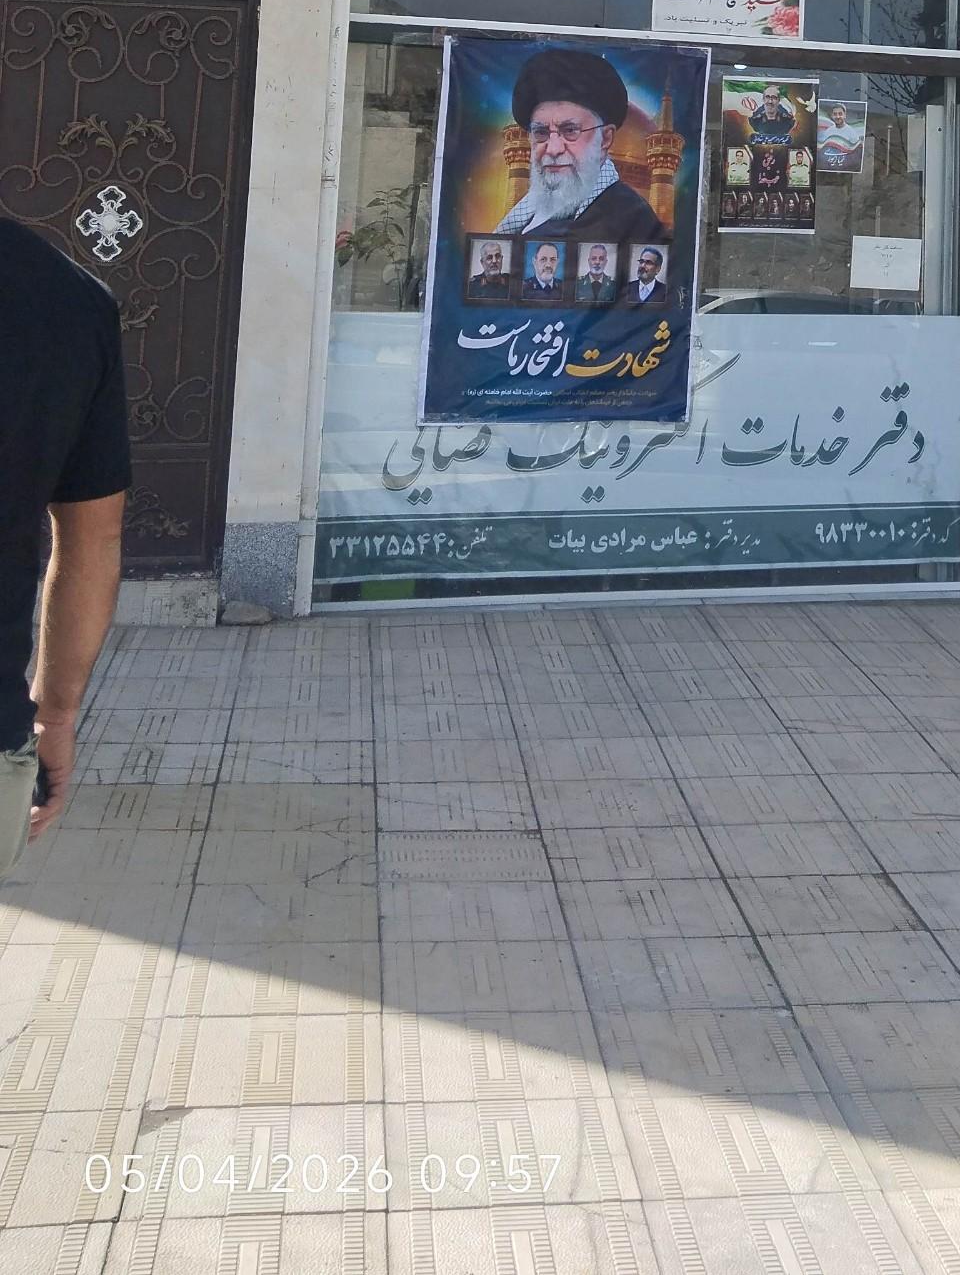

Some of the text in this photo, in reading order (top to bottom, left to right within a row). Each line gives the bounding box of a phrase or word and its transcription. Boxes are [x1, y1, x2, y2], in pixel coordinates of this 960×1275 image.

[509, 320, 570, 378] افتخار
[565, 319, 671, 378] شهادت
[720, 405, 850, 467] خدمات
[848, 381, 926, 476] دفتر
[548, 529, 586, 553] بیات
[590, 527, 646, 554] مرادی
[650, 526, 698, 551] عباس
